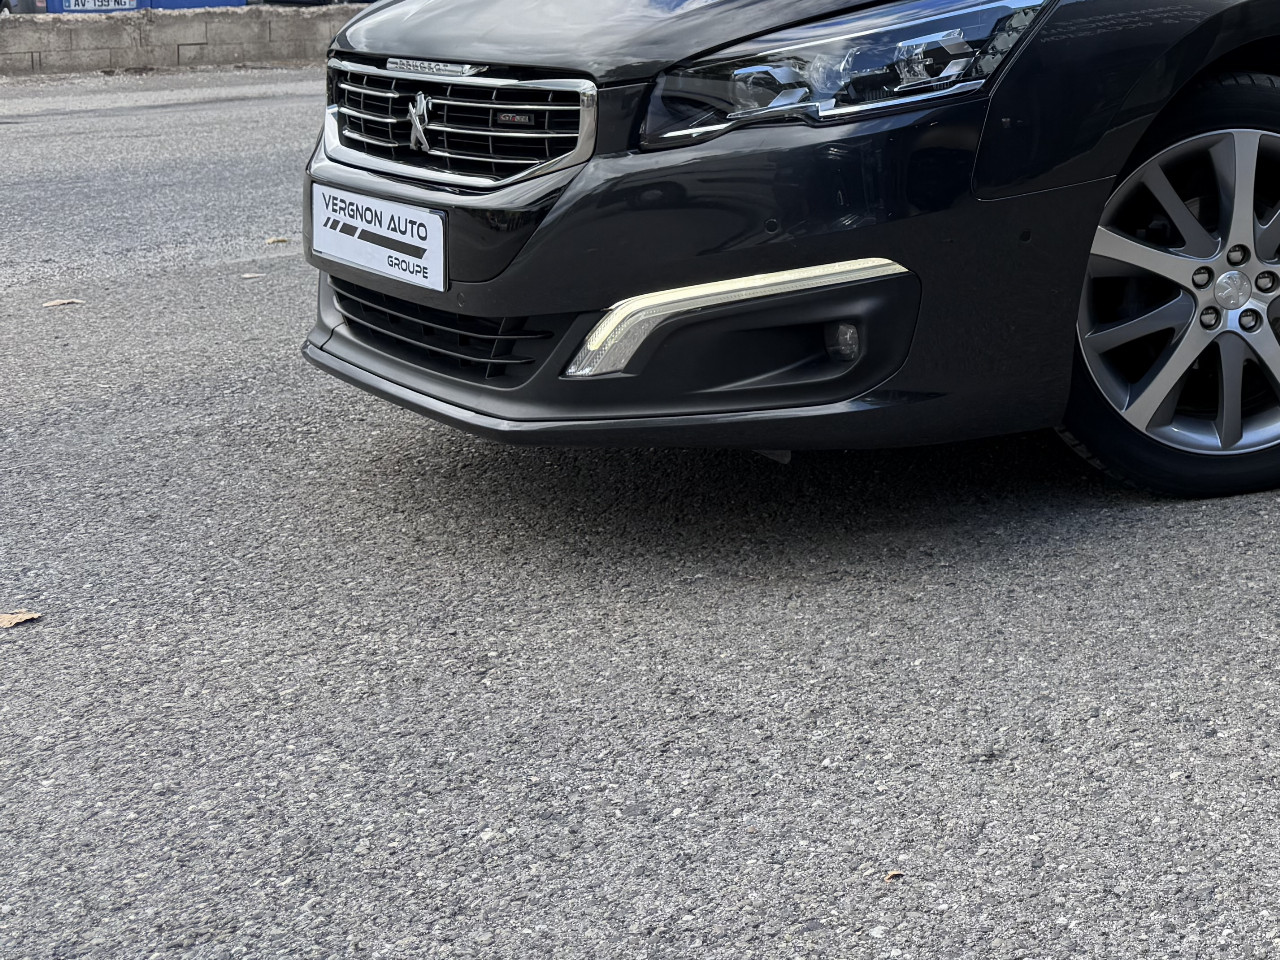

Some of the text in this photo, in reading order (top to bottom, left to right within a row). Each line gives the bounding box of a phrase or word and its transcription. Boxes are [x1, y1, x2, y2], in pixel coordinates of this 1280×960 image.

[322, 192, 428, 241] VERGNON AUTO
[387, 254, 429, 279] GROUPE
